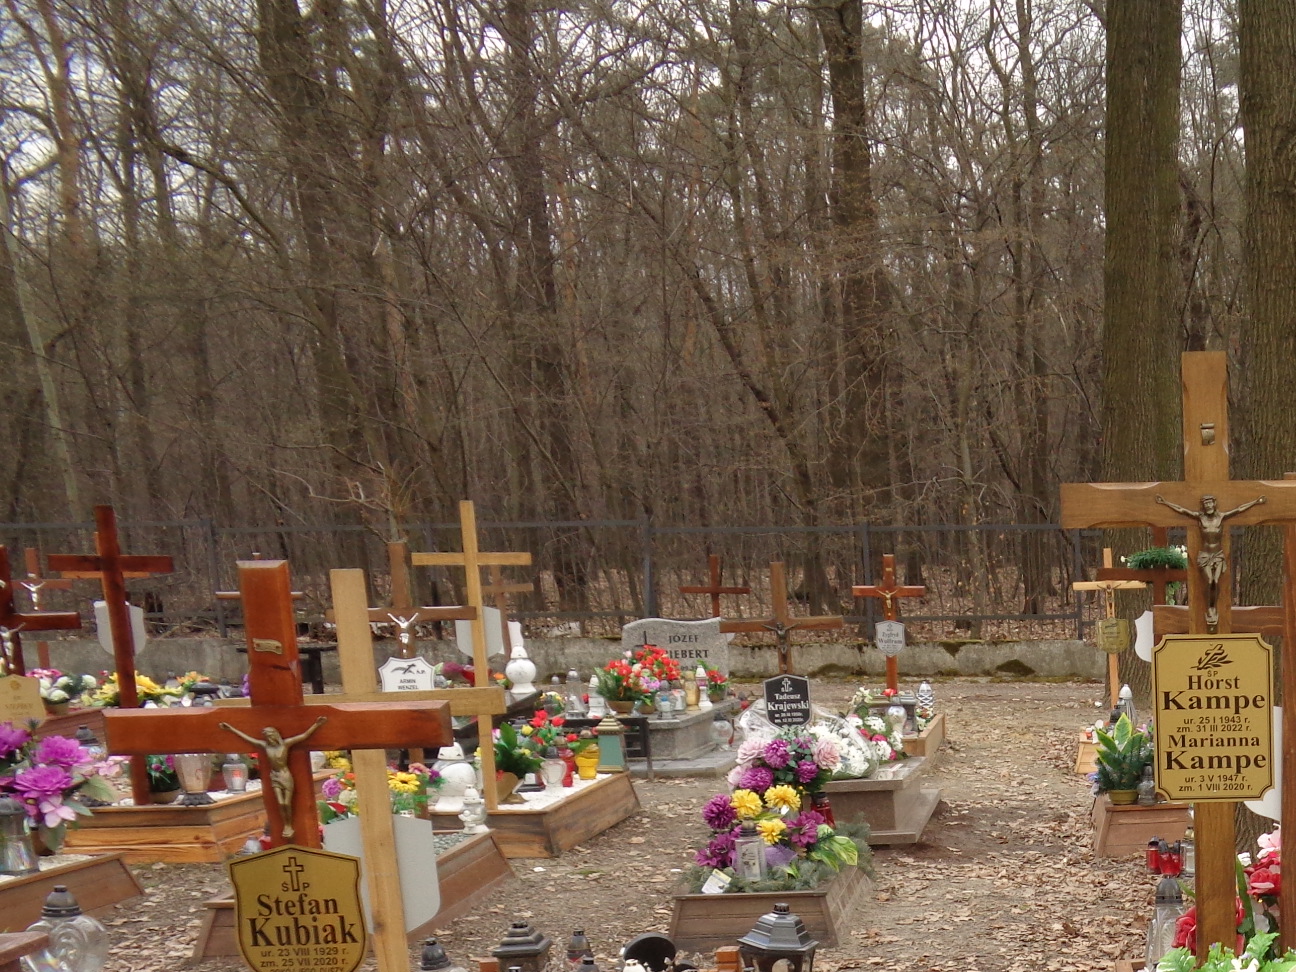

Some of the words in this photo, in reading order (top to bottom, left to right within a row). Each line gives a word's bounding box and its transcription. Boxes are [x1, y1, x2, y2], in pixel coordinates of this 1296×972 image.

[1186, 674, 1240, 690] Horst
[768, 700, 810, 711] Krajewski
[1161, 690, 1266, 714] Kampe
[1199, 716, 1210, 724] 25
[1220, 716, 1242, 724] 1943
[1196, 724, 1207, 732] 31
[1210, 724, 1218, 732] III
[1221, 724, 1244, 732] 2022
[1168, 734, 1260, 748] Marianna
[1164, 750, 1266, 774] Kampe
[1199, 774, 1205, 782] 3
[1208, 774, 1215, 782] V
[1218, 774, 1239, 782] 1947
[1206, 783, 1221, 792] VIII
[1223, 782, 1245, 791] 2020
[302, 882, 310, 892] P
[257, 893, 339, 916] Stefan
[246, 915, 358, 947] Kubiak
[261, 950, 275, 958] ur.
[278, 948, 290, 956] 23
[314, 947, 338, 956] 1929
[260, 960, 279, 968] zm.
[282, 958, 294, 966] 25
[314, 957, 338, 966] 2020
